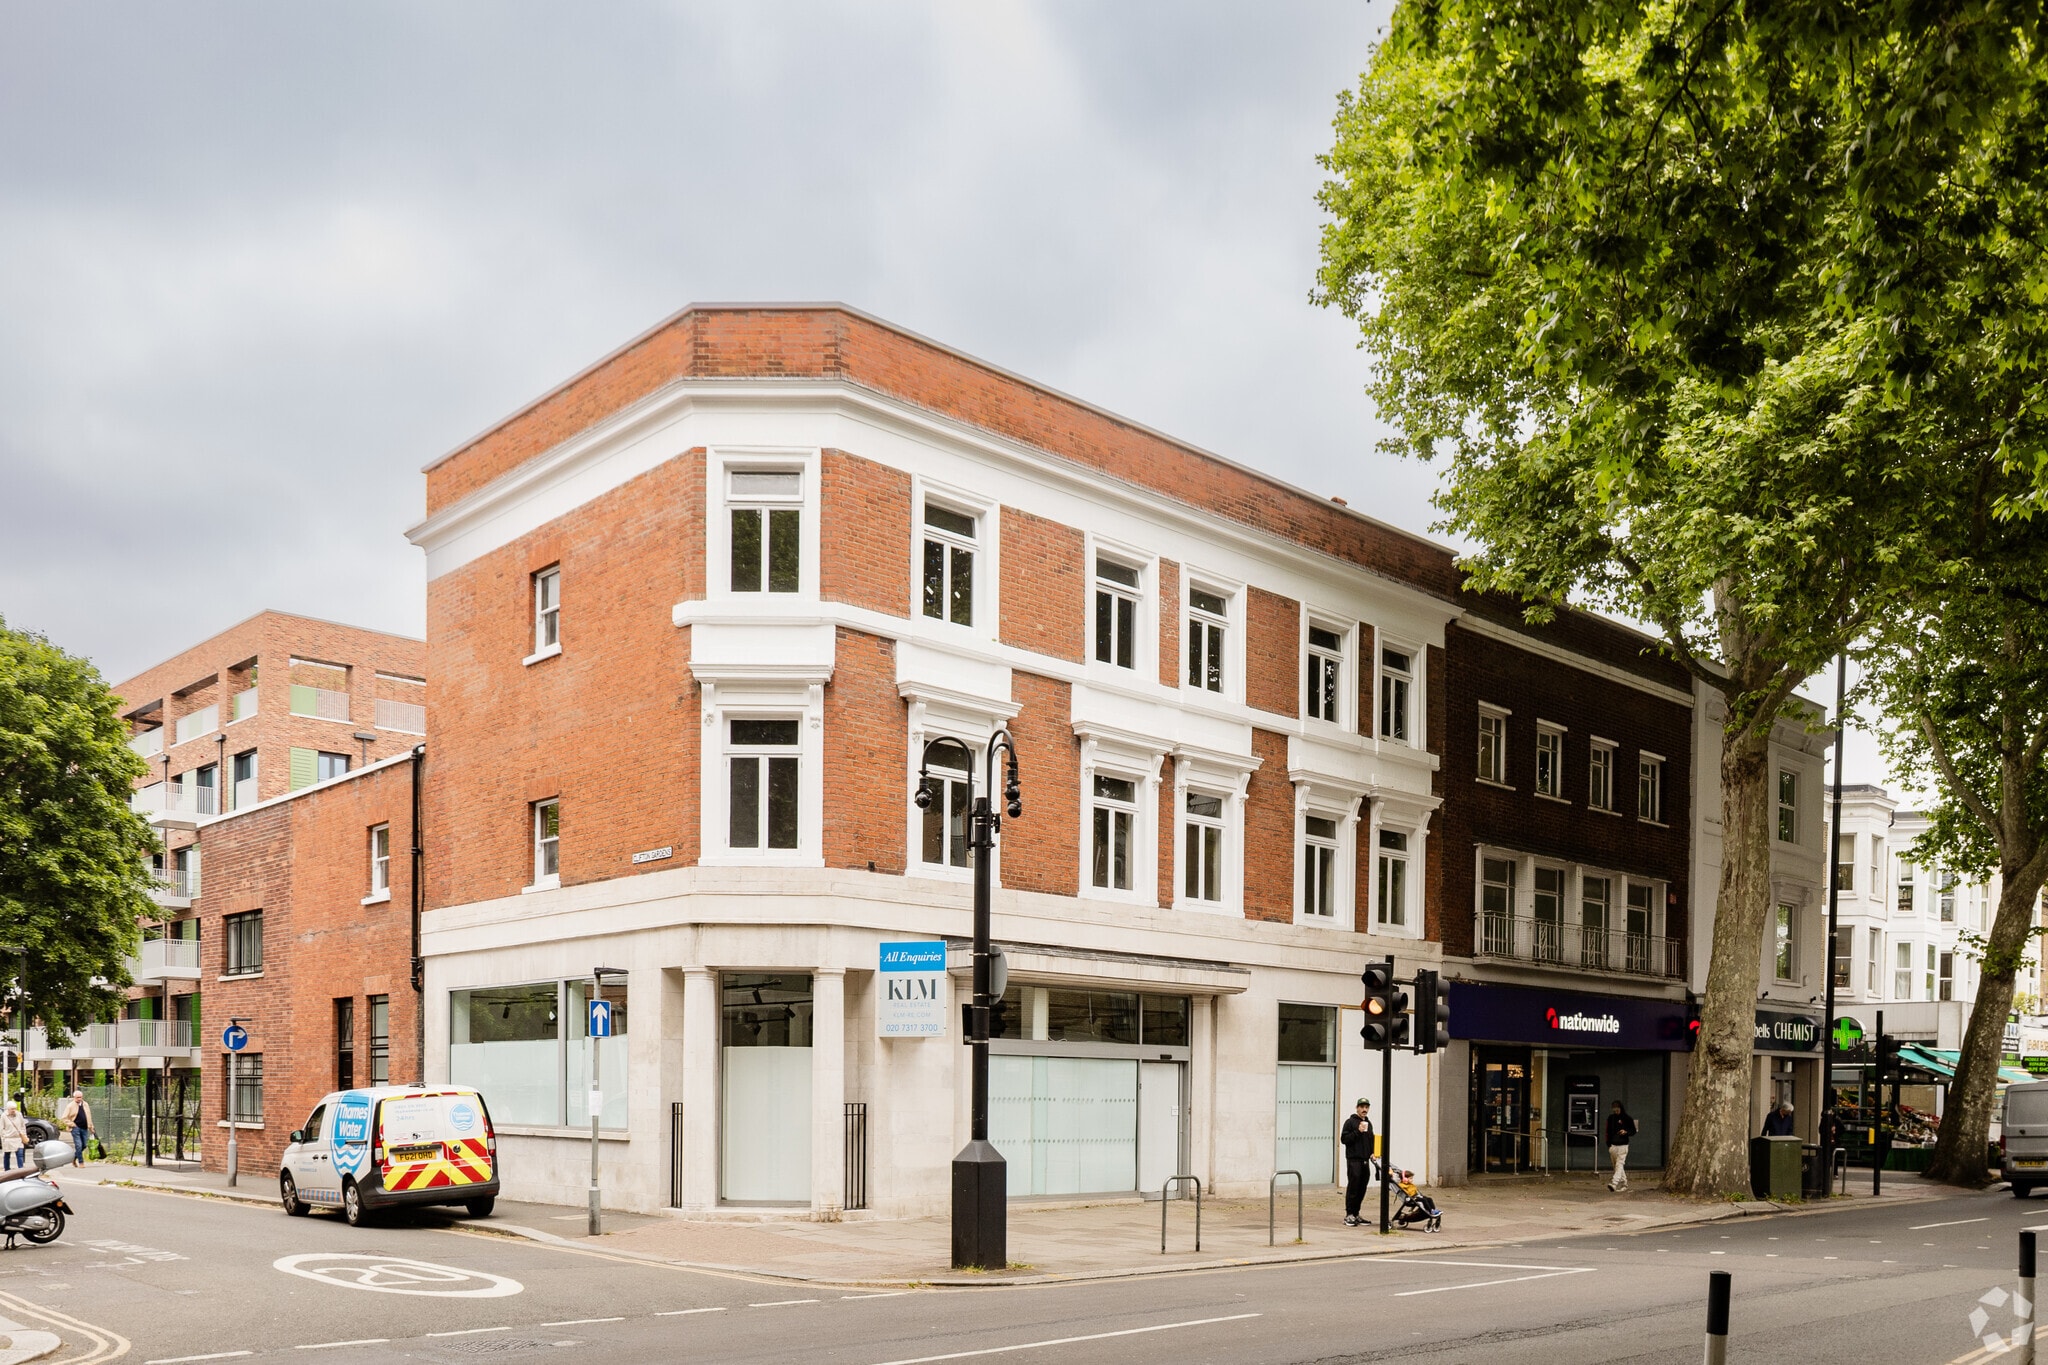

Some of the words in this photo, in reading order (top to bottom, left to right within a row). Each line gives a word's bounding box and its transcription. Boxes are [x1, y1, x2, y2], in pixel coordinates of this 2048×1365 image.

[883, 951, 899, 962] All
[899, 951, 942, 965] Enquiries
[888, 978, 936, 1000] KLM
[885, 1024, 900, 1032] 020
[901, 1024, 918, 1032] 7317
[920, 1023, 938, 1032] 3700
[1559, 1012, 1620, 1033] nationwide
[1774, 1021, 1815, 1042] CHEMIST
[339, 1103, 368, 1120] Thames
[339, 1121, 362, 1137] Water
